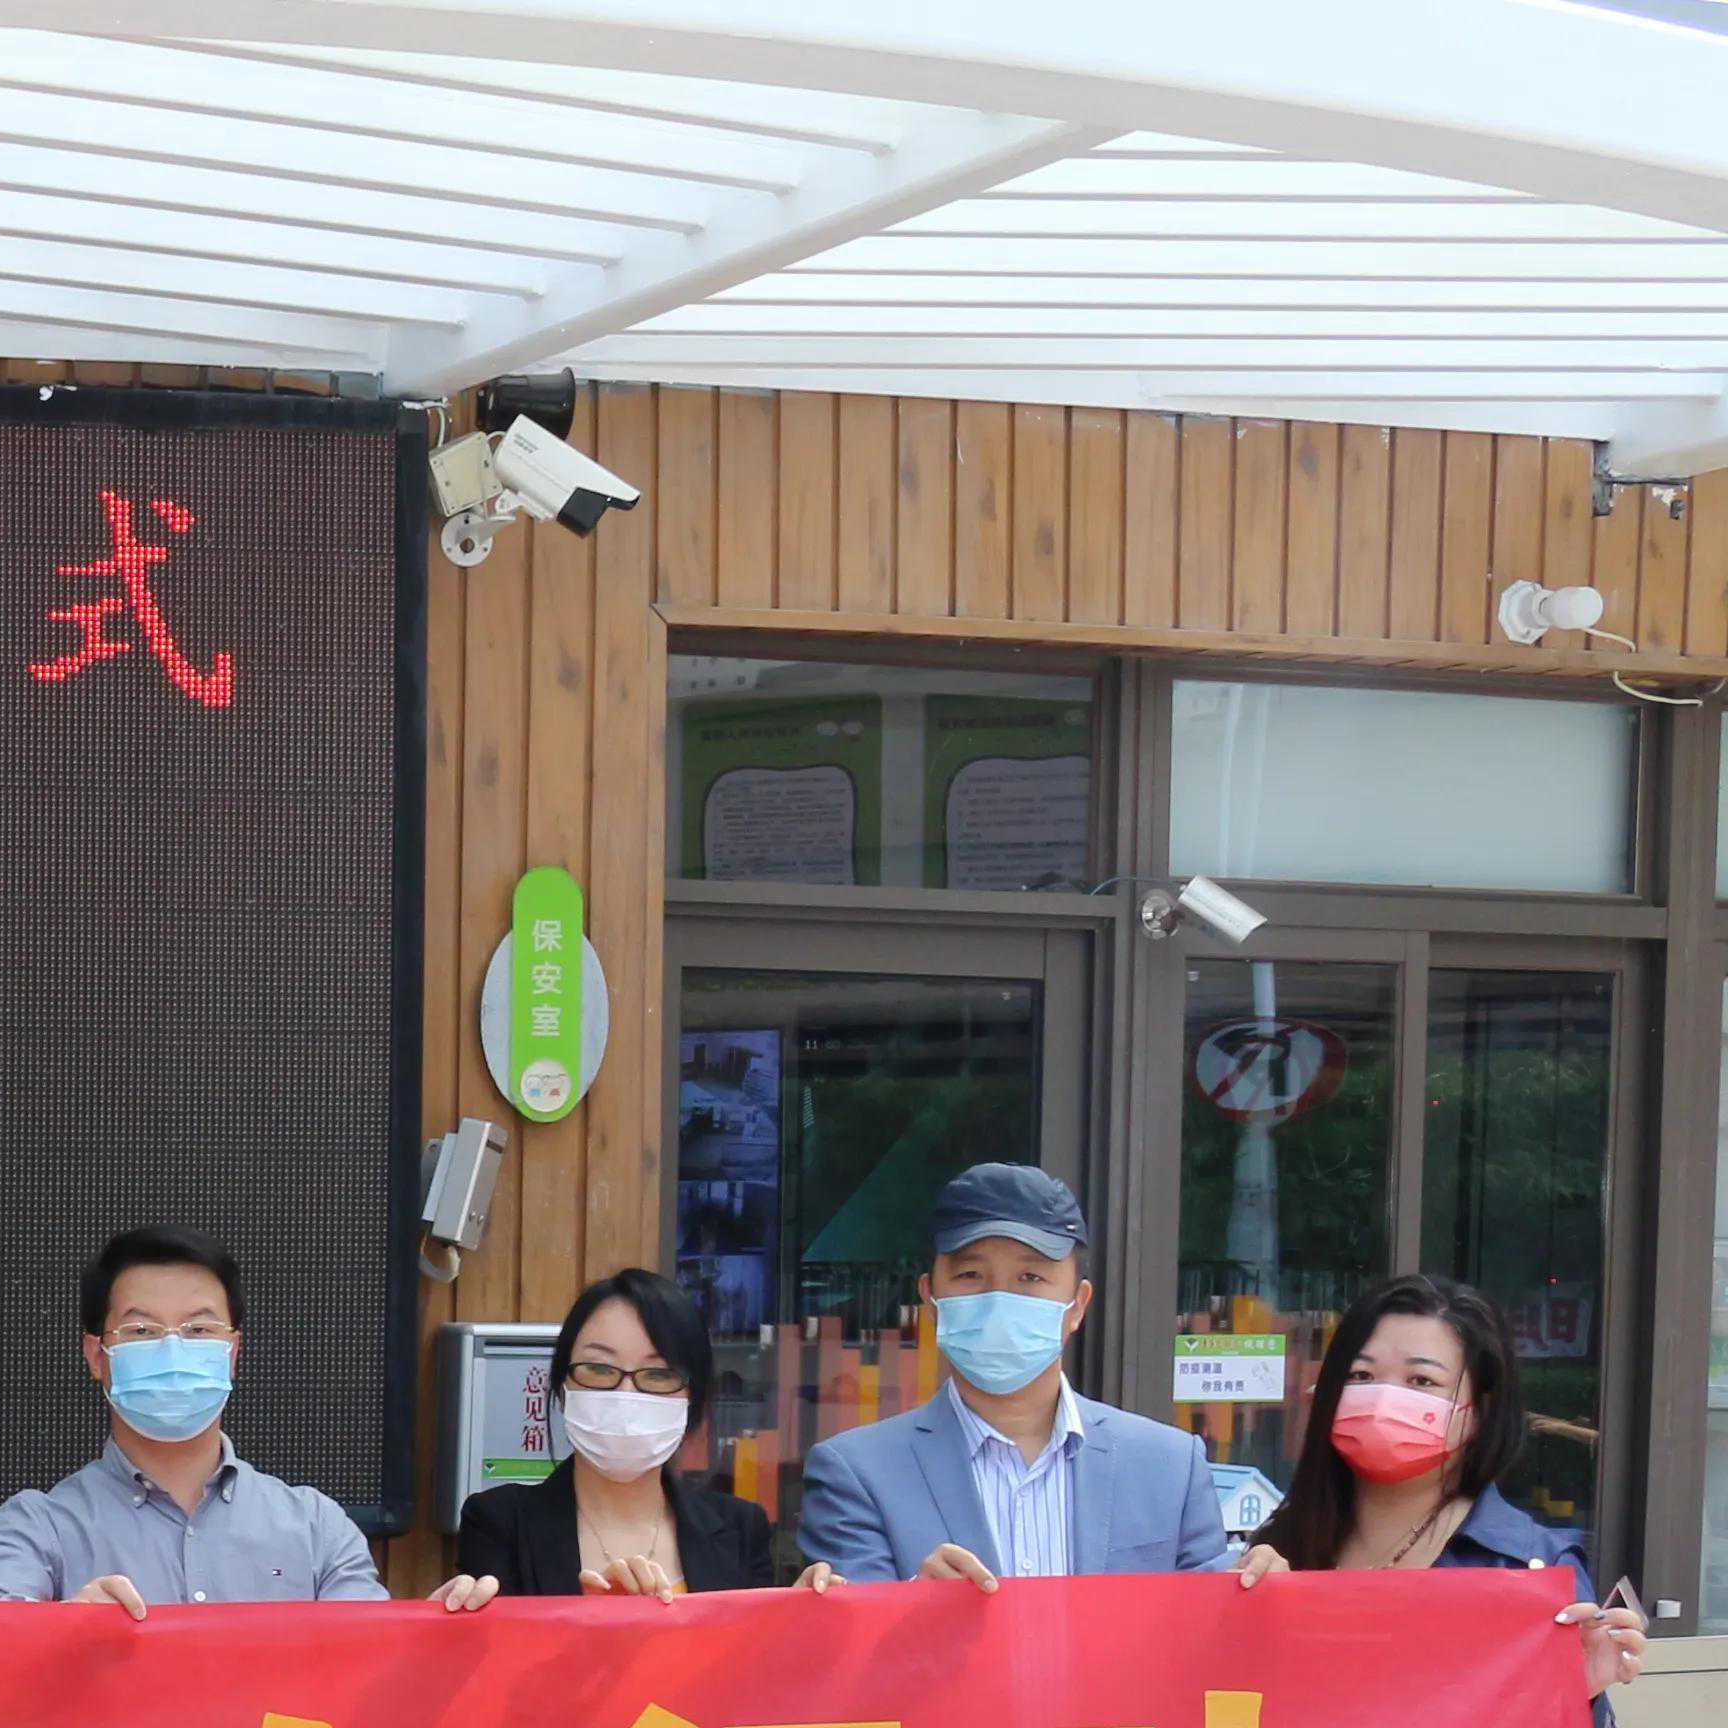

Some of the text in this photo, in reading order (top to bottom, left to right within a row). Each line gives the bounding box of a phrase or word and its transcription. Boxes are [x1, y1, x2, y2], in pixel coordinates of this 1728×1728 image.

[531, 919, 564, 1037] 保安室
[522, 1366, 548, 1452] 意见箱
